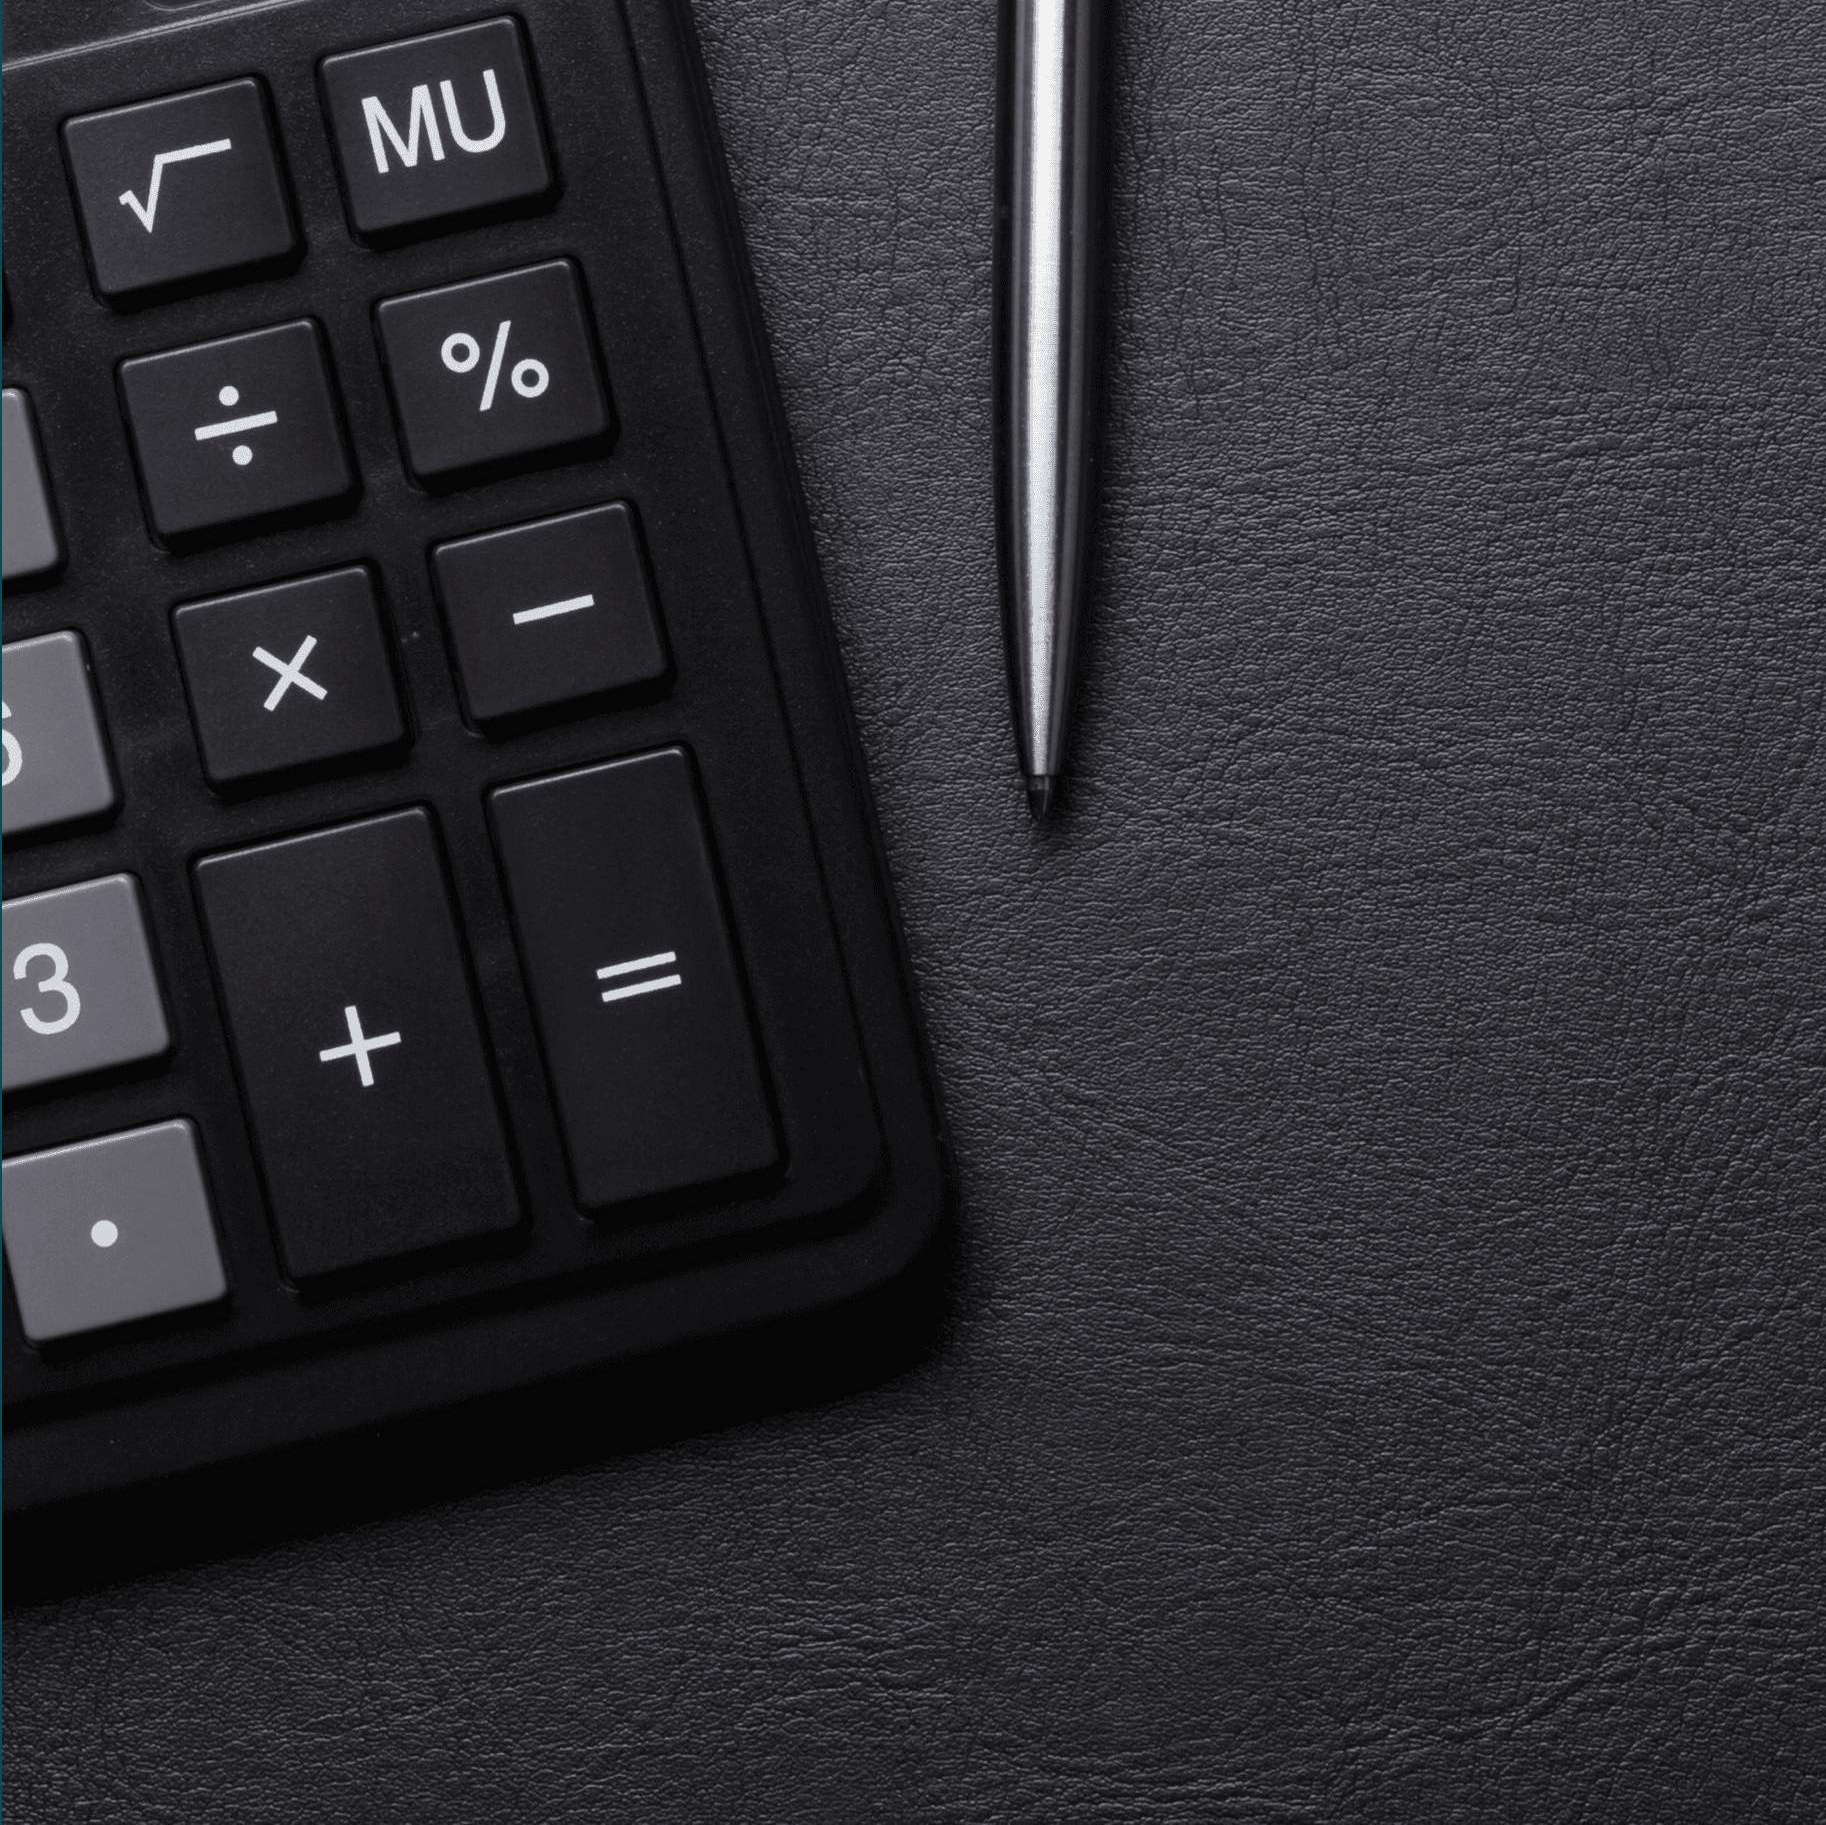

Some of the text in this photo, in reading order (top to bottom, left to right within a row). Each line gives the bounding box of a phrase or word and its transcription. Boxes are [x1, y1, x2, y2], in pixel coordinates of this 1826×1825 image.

[362, 69, 506, 173] MU
[441, 321, 549, 411] %
[13, 942, 81, 1035] 3
